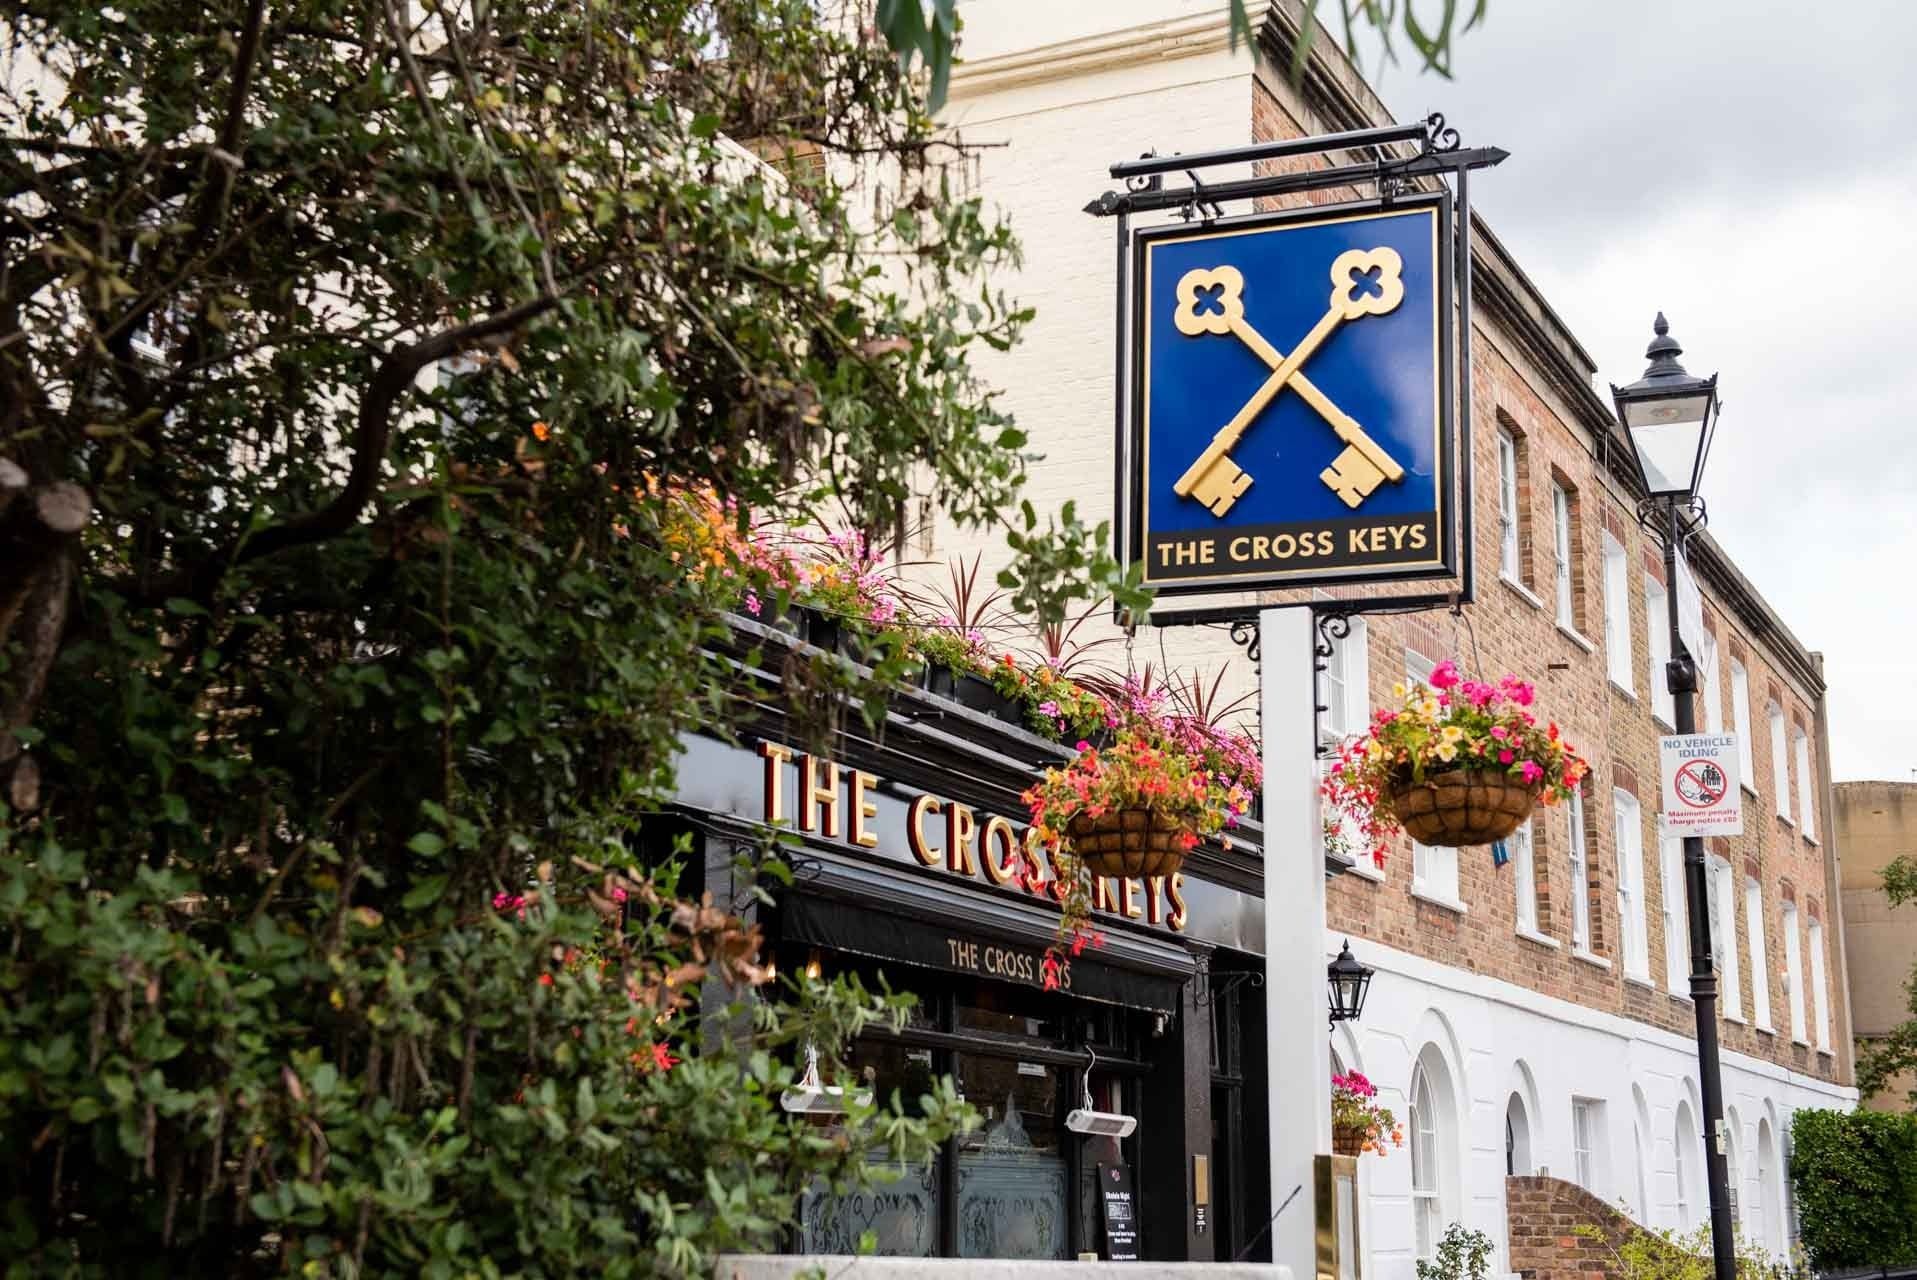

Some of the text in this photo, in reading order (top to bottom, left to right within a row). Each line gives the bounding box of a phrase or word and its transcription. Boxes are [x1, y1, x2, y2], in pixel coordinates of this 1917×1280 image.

[1157, 523, 1428, 567] THE CROSS KEYS
[1664, 737, 1734, 749] NO VEHICLE
[1679, 748, 1719, 758] IDLING
[757, 741, 879, 848] THE
[1709, 808, 1738, 817] penalty
[1669, 818, 1696, 826] charge
[947, 939, 1071, 989] THE CROSS KYS
